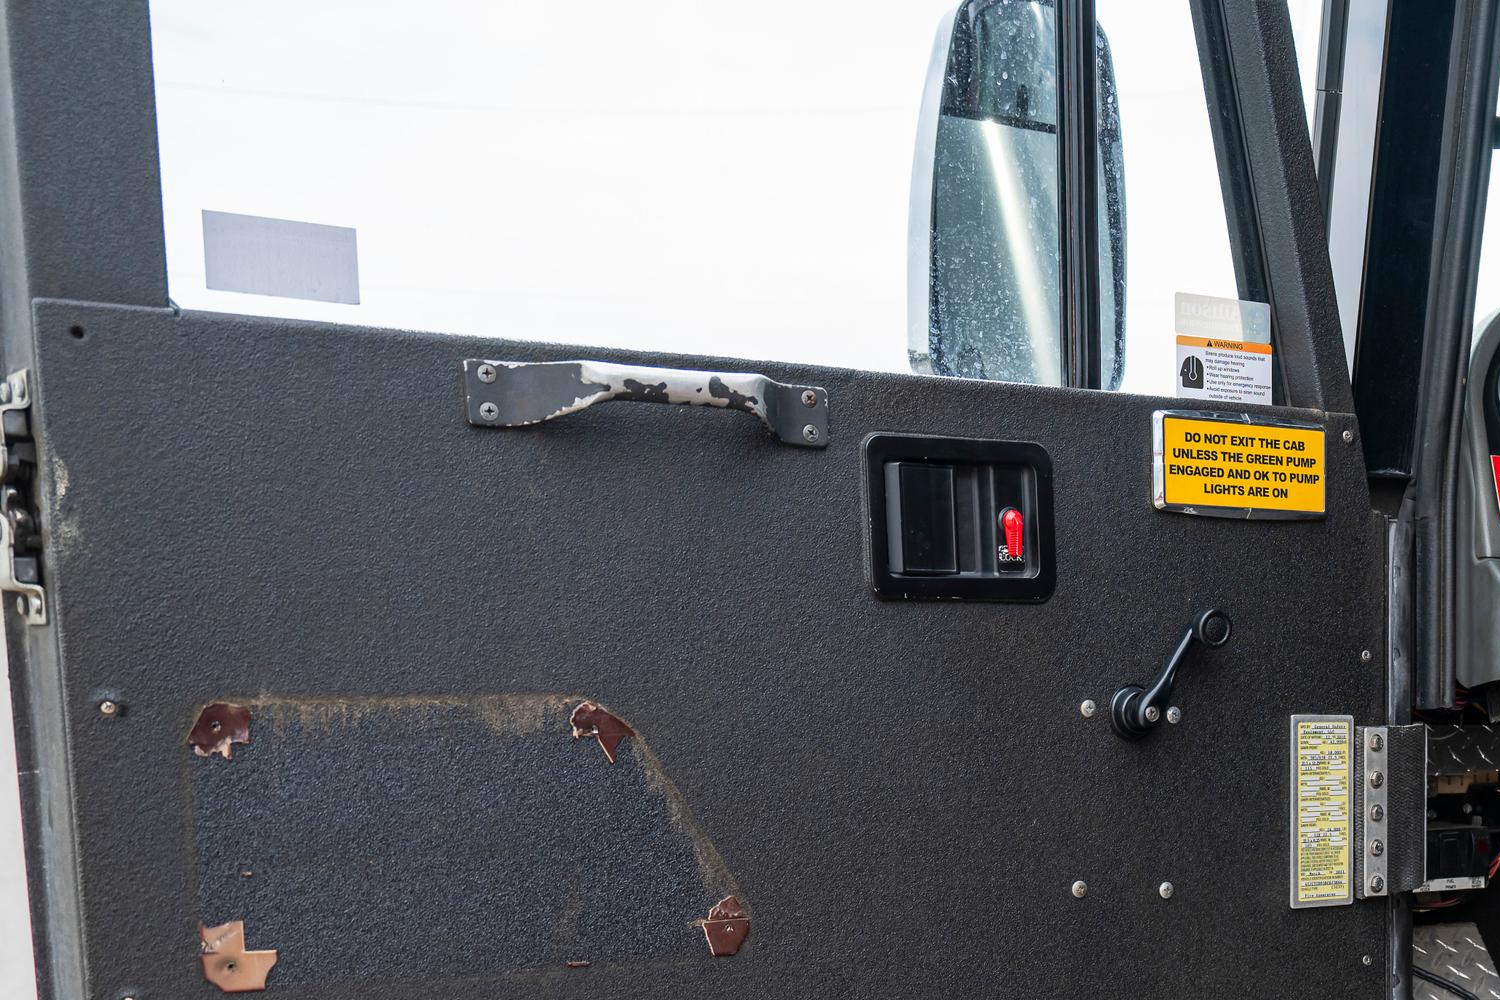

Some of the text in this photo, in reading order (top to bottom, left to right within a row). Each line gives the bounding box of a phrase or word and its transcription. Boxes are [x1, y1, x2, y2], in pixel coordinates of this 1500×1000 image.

[1214, 341, 1243, 350] WARNING
[1185, 432, 1305, 451] DO NOT EXIT THE CAB
[1173, 449, 1316, 468] UNLESS THE GREEN PUMP
[1170, 465, 1319, 484] ENGAGED AND OK TO PUMP
[1204, 483, 1288, 498] LIGHTS ARE ON
